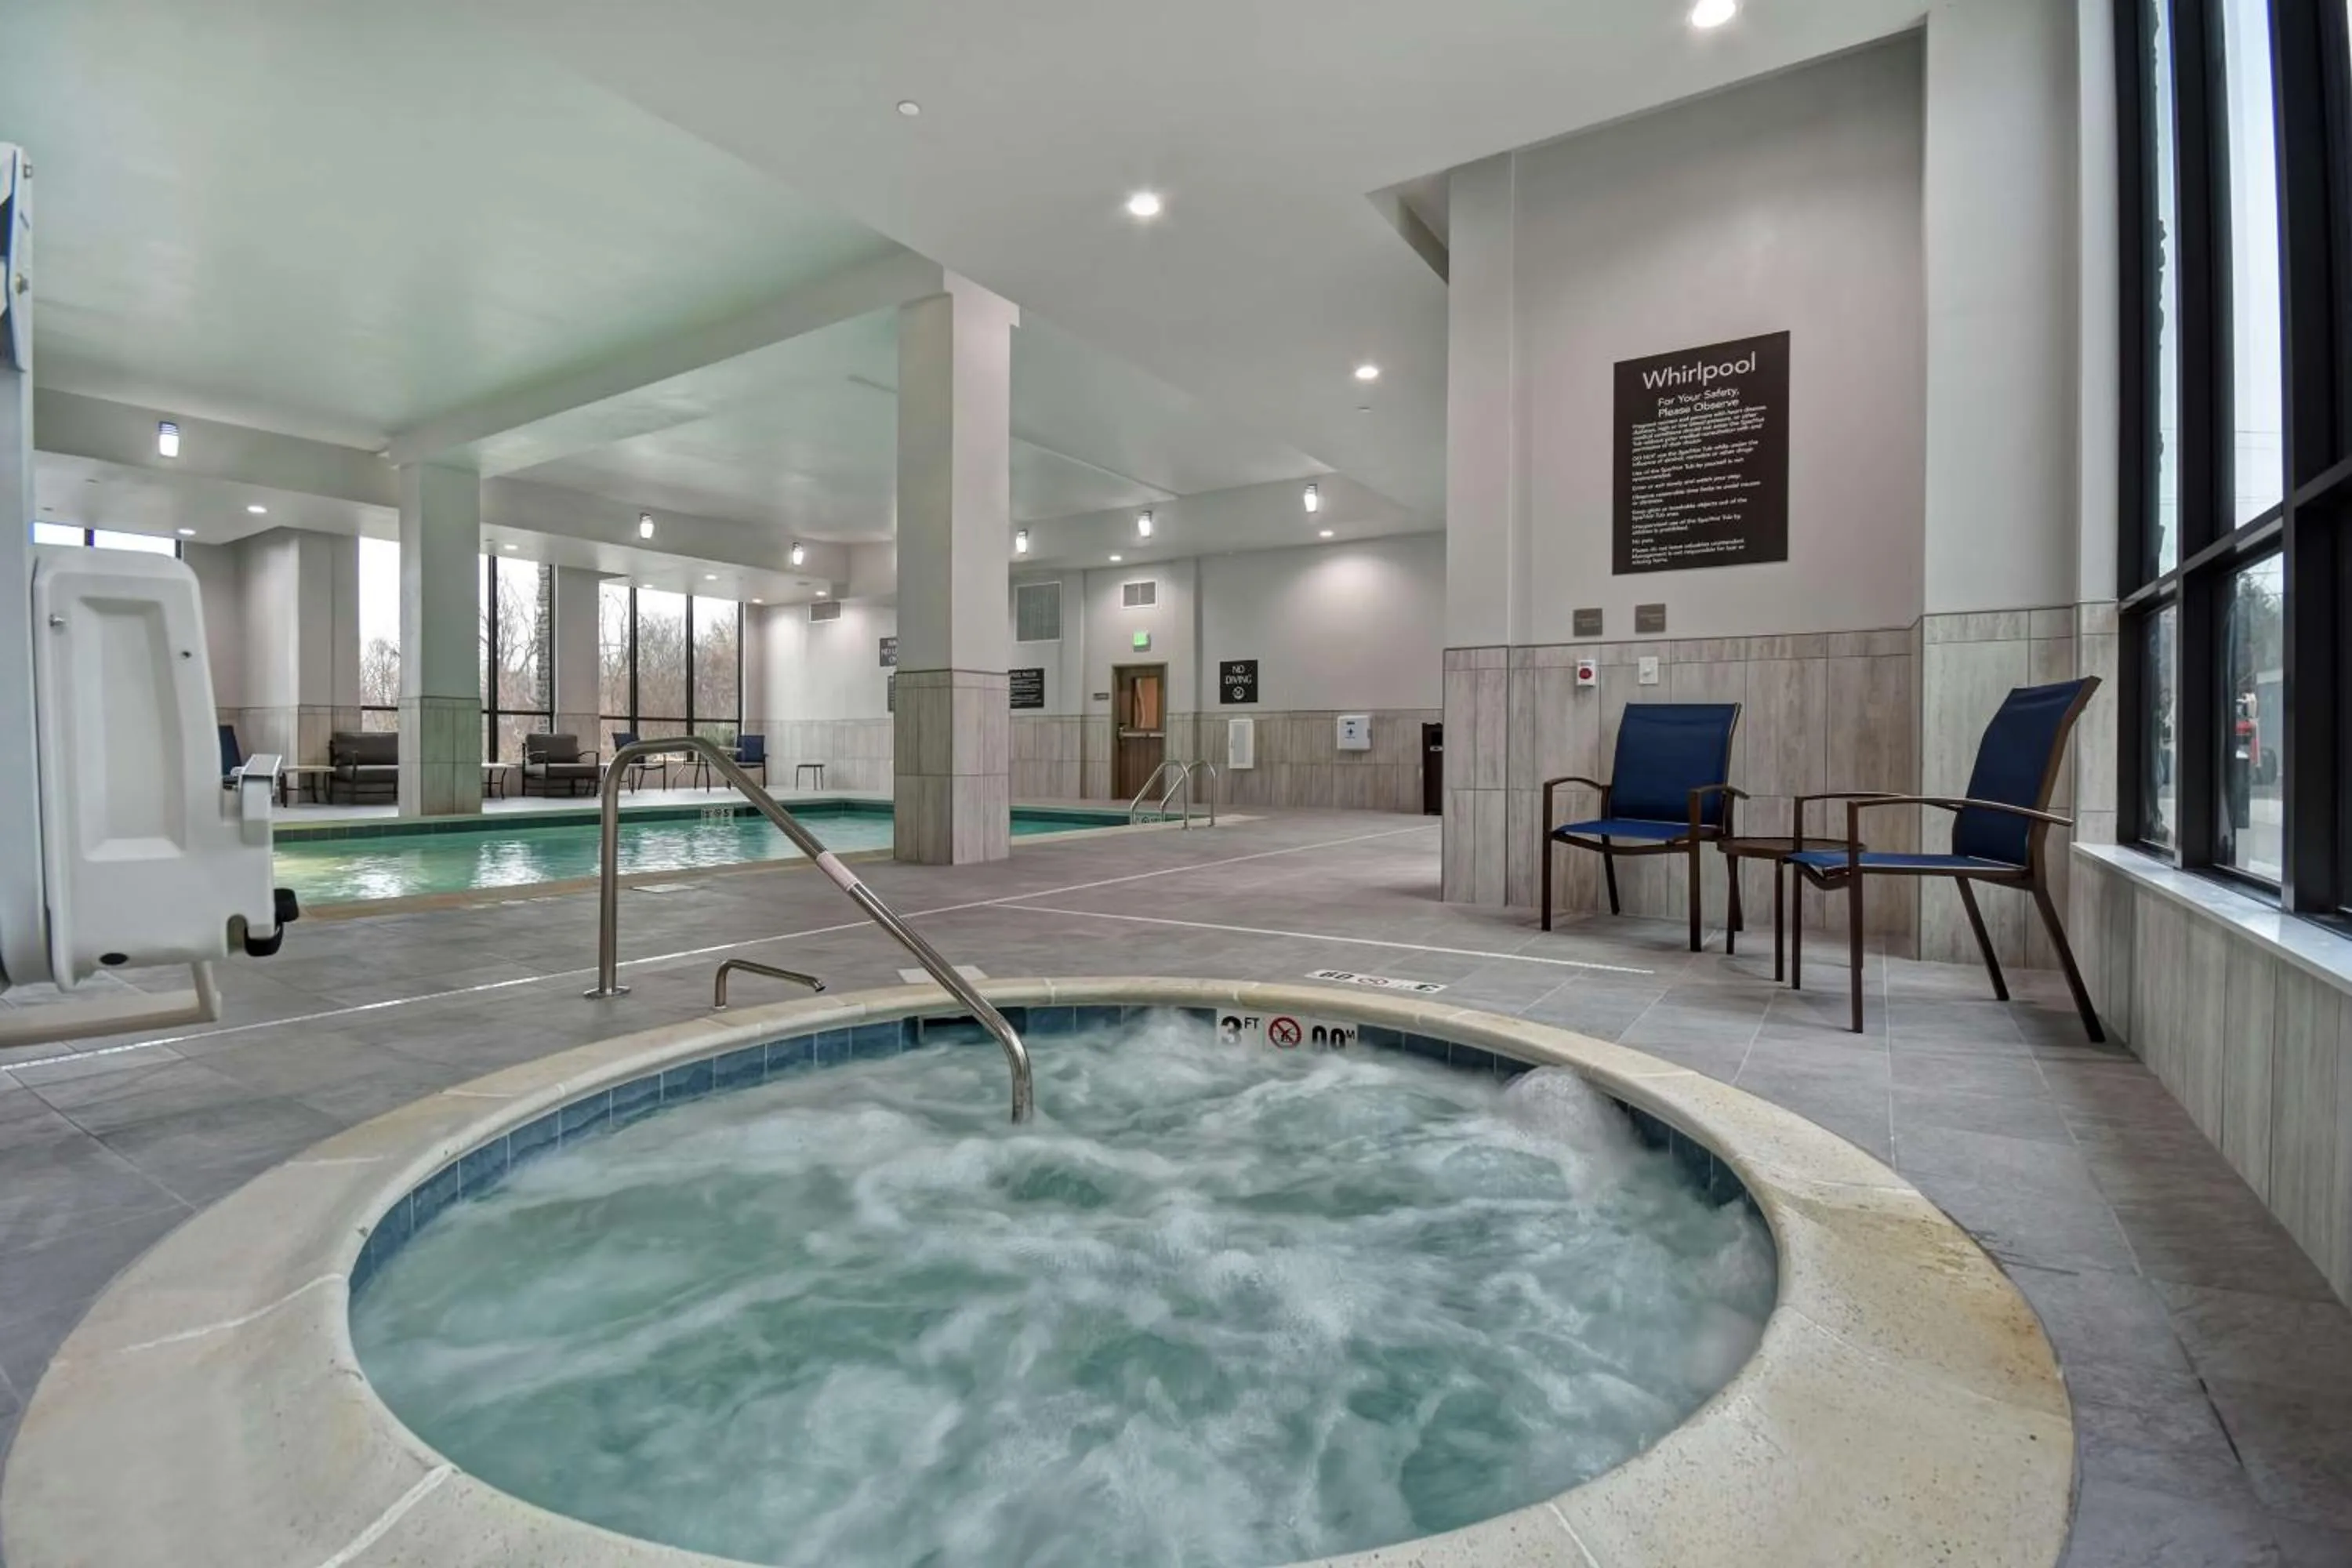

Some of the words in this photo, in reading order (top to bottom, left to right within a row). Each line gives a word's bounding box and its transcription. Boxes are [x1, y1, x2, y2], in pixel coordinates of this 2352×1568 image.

[1642, 351, 1755, 390] Whirlpool
[1658, 397, 1675, 407] For
[1678, 393, 1701, 403] Your
[1659, 406, 1691, 418] Please
[1694, 399, 1740, 412] Observe
[1232, 664, 1245, 674] NO
[1221, 1015, 1242, 1045] 3
[1244, 1017, 1260, 1029] FT
